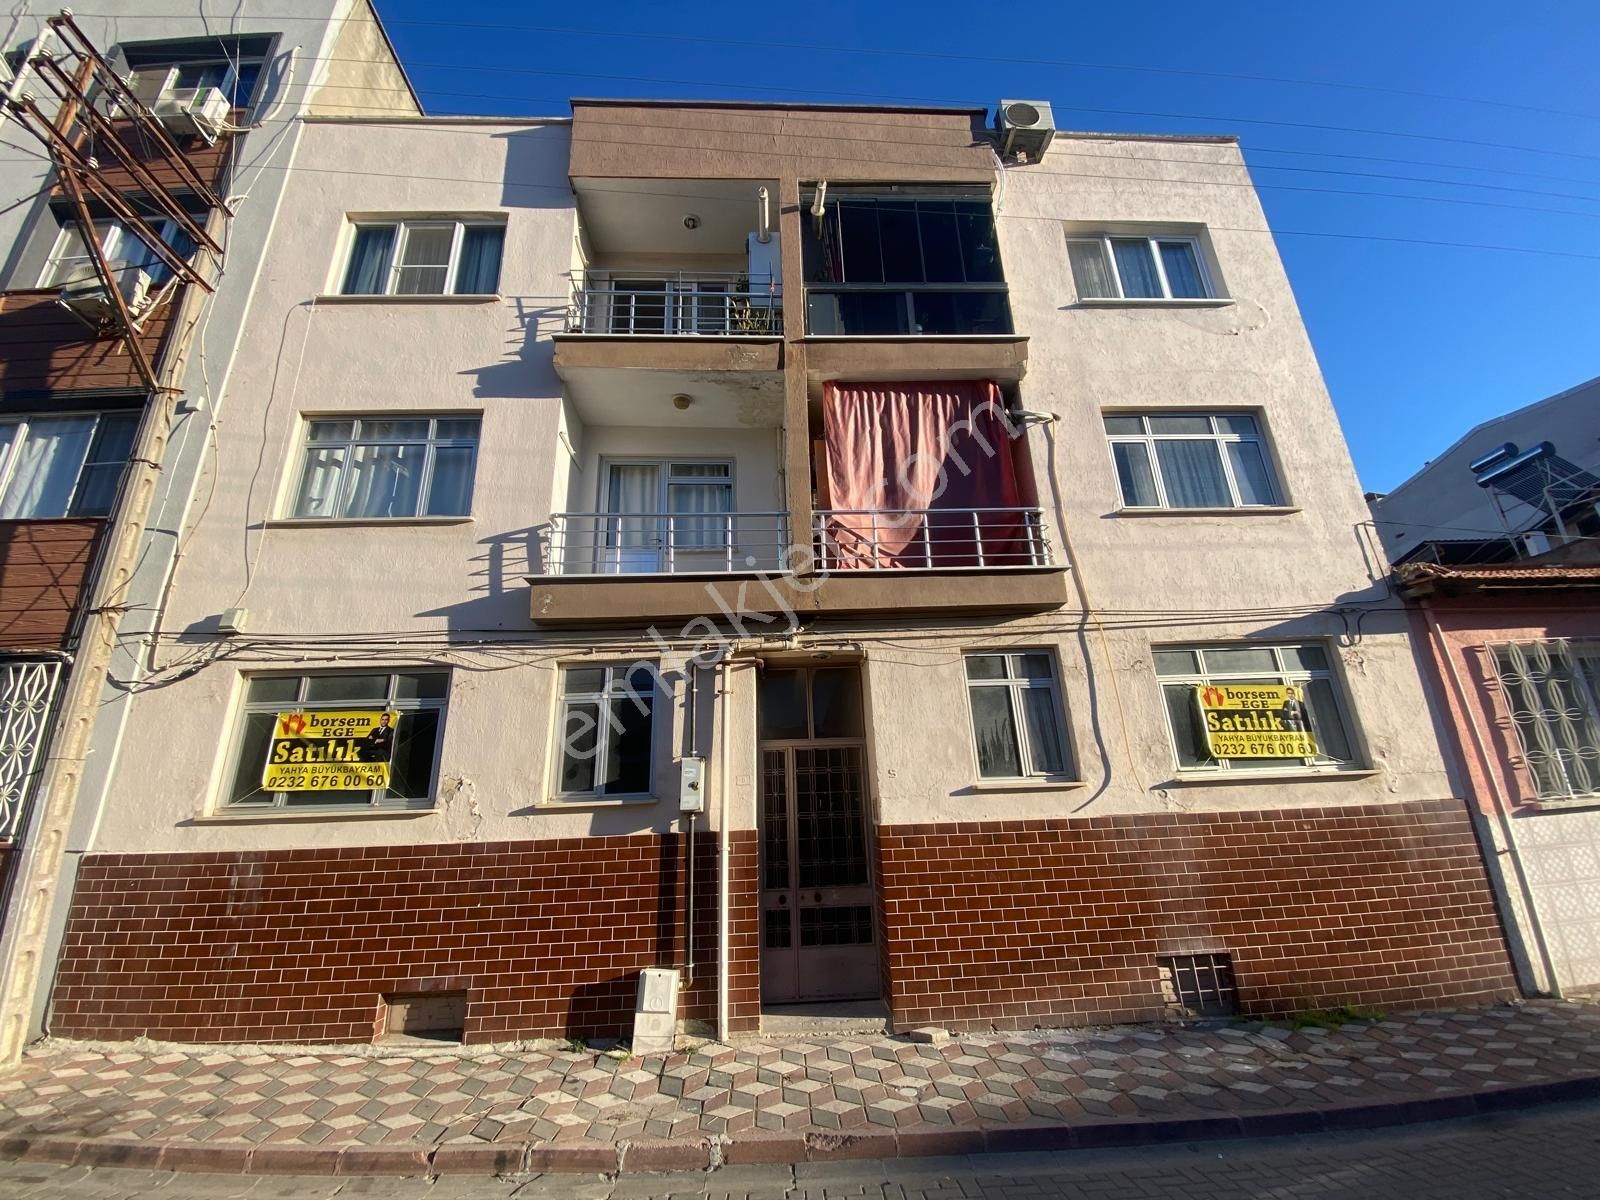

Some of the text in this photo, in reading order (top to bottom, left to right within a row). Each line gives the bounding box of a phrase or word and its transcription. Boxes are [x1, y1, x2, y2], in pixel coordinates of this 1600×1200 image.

[1225, 688, 1280, 699] borsem
[1241, 700, 1270, 709] EGE
[310, 715, 371, 727] borsem
[1207, 711, 1285, 732] Satılık
[322, 728, 355, 737] EGE
[274, 739, 362, 763] Satılık
[1214, 743, 1313, 755] 0232 676 00 60
[280, 765, 381, 774] YAHYA BÜYÜKBAYRAM
[268, 774, 385, 788] 0232 676 00 60
